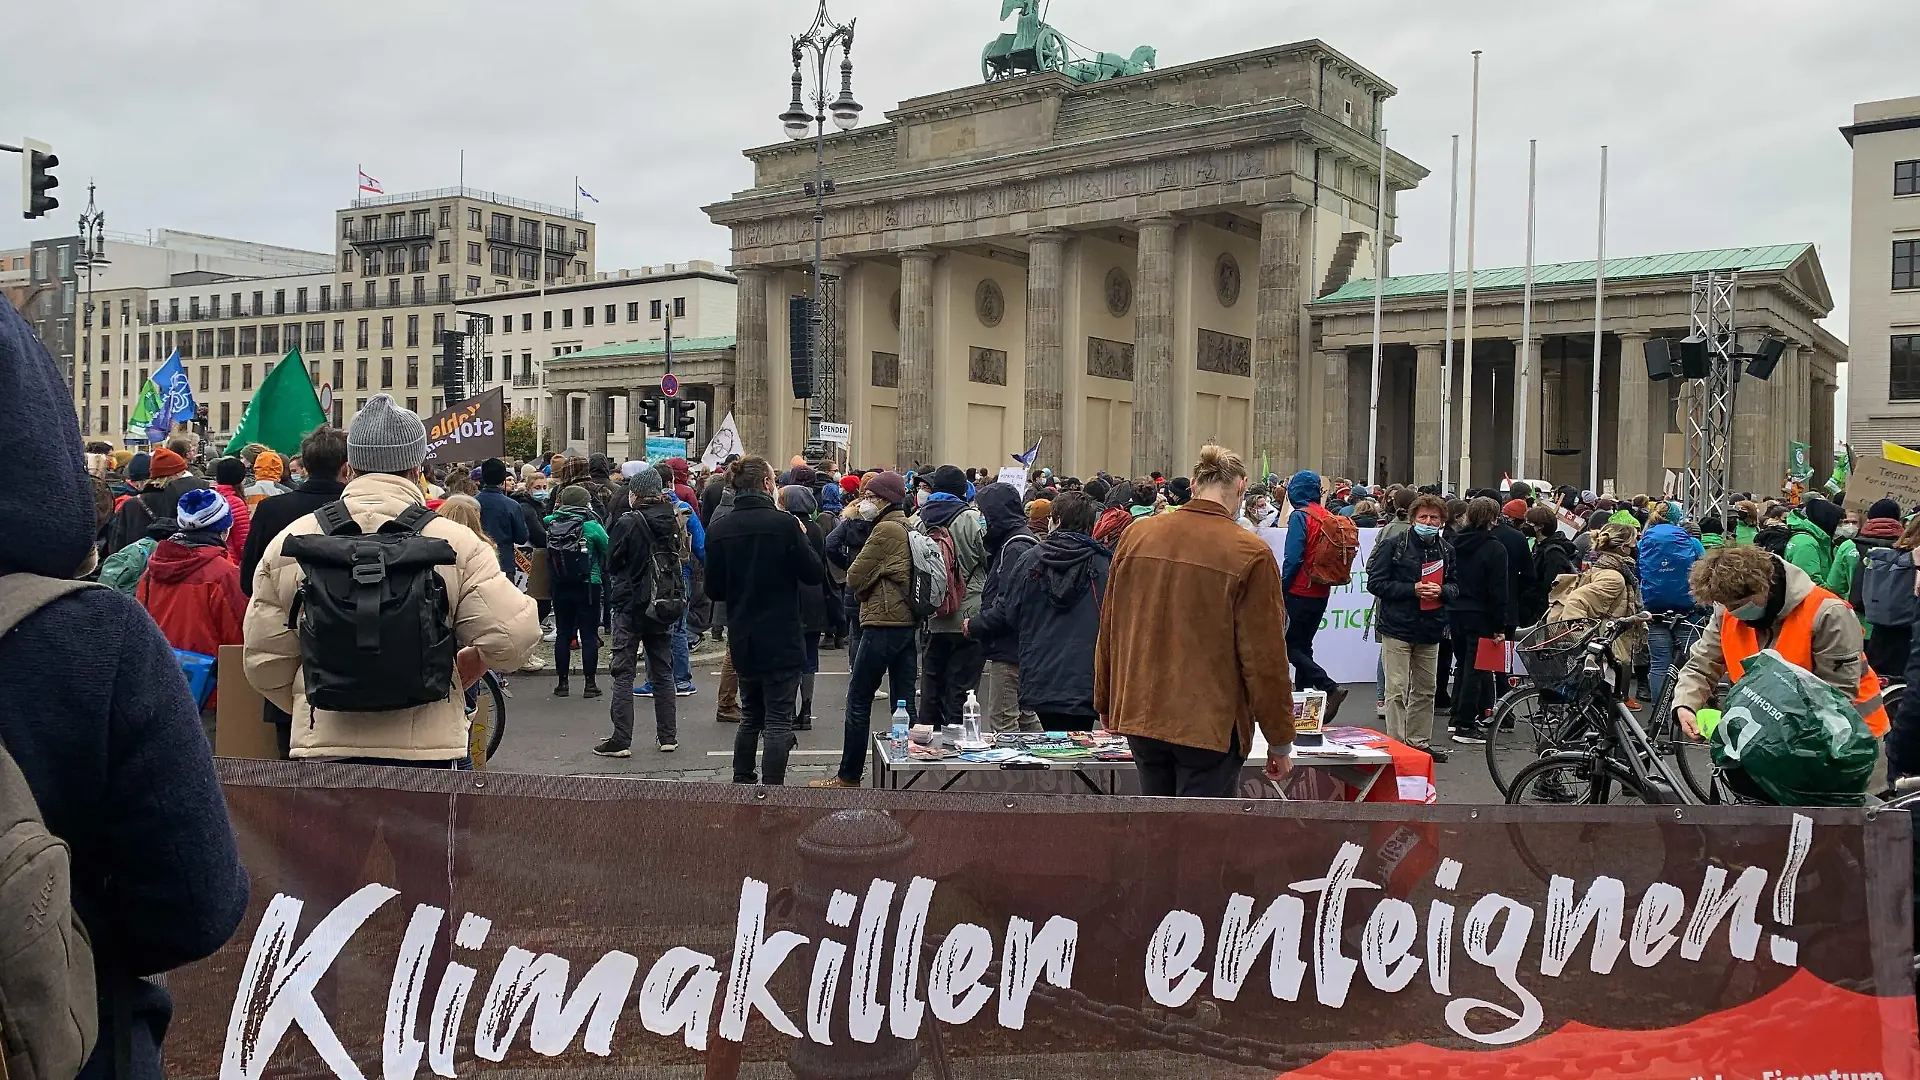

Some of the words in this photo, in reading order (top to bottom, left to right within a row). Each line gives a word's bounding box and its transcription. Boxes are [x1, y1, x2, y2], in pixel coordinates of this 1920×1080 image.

[820, 424, 848, 434] SPENDEN
[218, 875, 1079, 1080] Klimakiller
[1143, 812, 1814, 1046] enteignen!
[1762, 1068, 1885, 1080] Eitum
